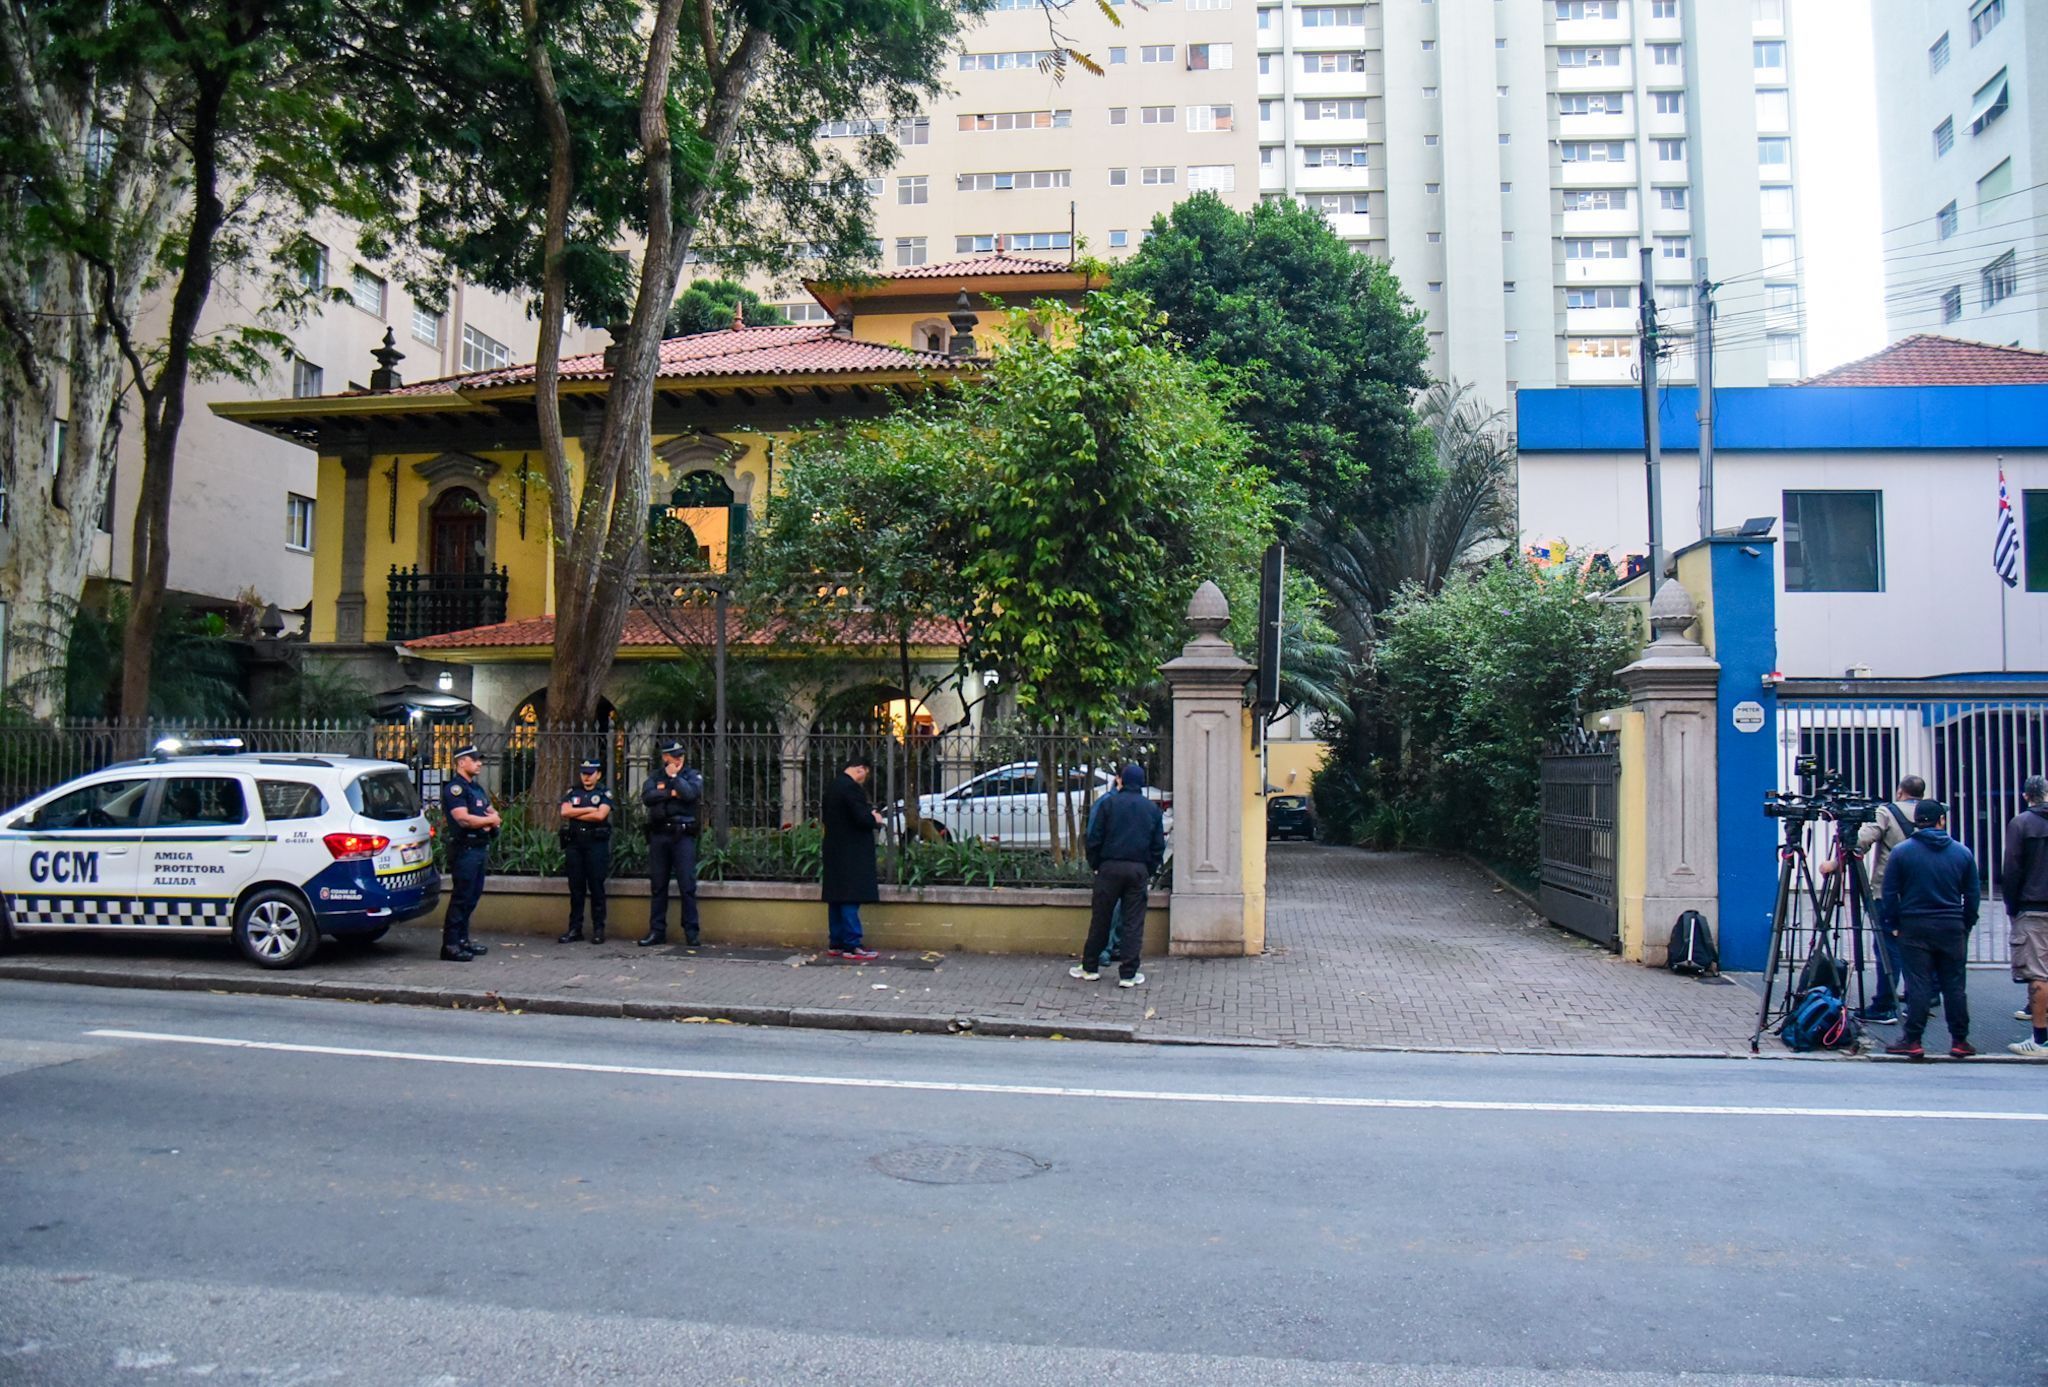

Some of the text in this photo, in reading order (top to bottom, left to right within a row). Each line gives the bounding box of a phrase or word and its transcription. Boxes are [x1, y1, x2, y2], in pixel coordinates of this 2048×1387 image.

[154, 852, 193, 860] AMIGA
[30, 850, 99, 883] GCM
[154, 864, 225, 874] PROTETORA
[153, 877, 197, 886] ALIADA
